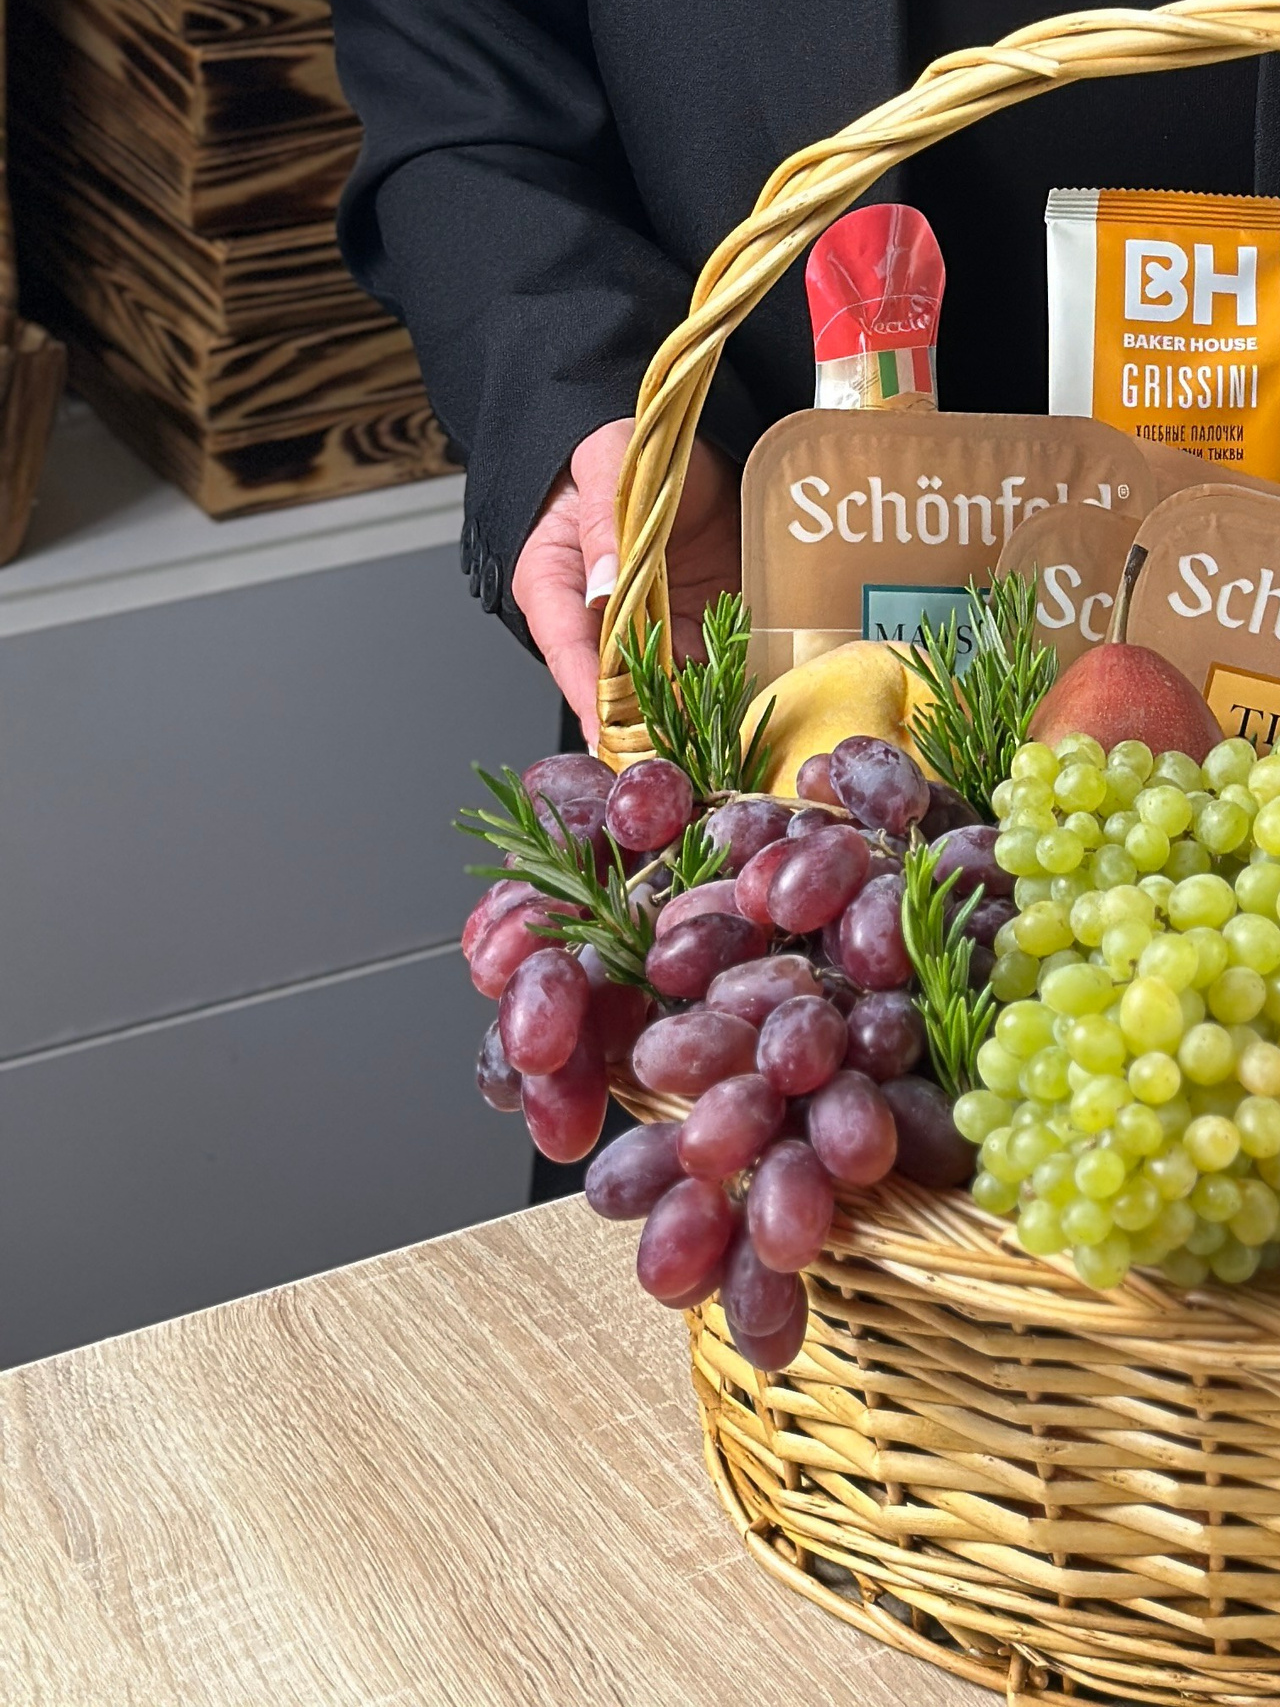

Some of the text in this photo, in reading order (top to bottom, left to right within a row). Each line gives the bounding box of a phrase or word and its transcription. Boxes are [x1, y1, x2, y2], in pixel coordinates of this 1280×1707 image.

[1124, 239, 1258, 326] BH
[1123, 333, 1258, 353] BAKER HOUSE
[1122, 363, 1259, 409] GRISSINI
[1191, 424, 1244, 442] ПАЛОЧКИ
[1208, 447, 1244, 461] ТЫКВЫ
[788, 475, 1112, 545] Schönf
